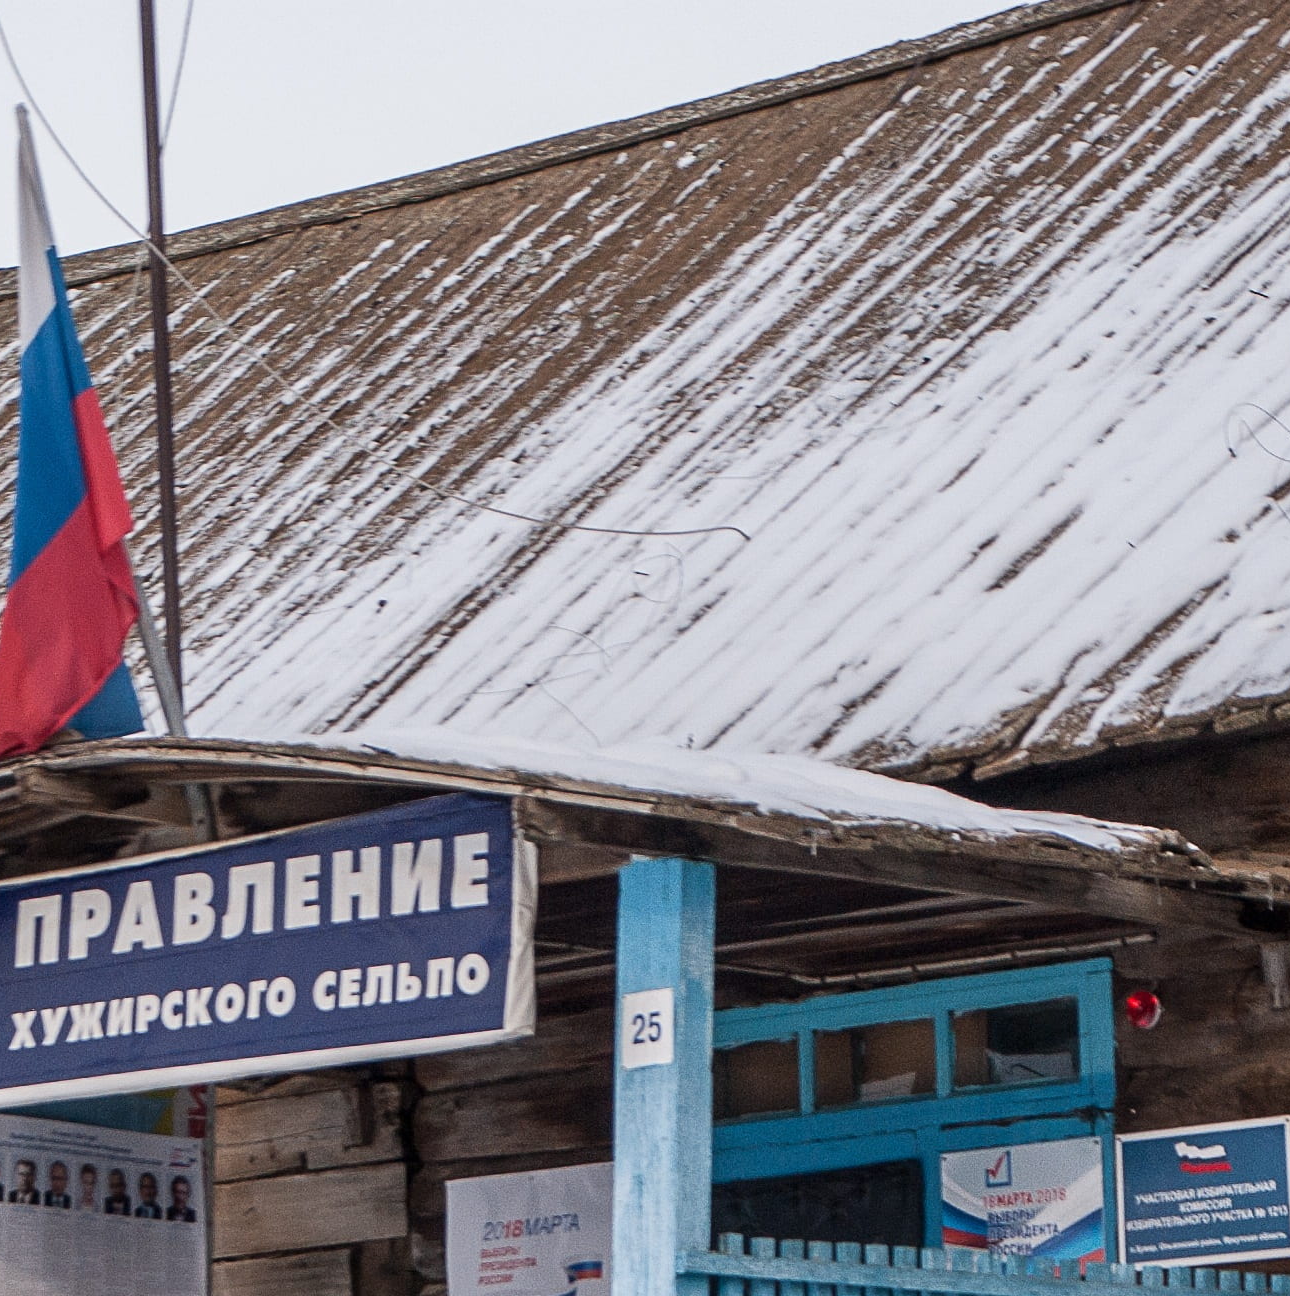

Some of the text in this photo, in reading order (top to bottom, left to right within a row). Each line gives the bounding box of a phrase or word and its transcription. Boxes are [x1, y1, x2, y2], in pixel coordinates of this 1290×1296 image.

[15, 832, 490, 969] ПРАВЛЕНИЕ
[9, 953, 490, 1051] ХУЖИРСКОГО СЕЛЬПО
[632, 1011, 661, 1044] 25
[1134, 1179, 1277, 1205] УЧАСТКОВАЯ ИЗБИРАТЕЛЬНАЯ
[1178, 1197, 1233, 1212] КОМИССИЯ
[988, 1208, 1037, 1225] ВЫБОРЫ
[1126, 1212, 1210, 1231] ИЗБИРАТЕЛЬНОГО
[1211, 1207, 1253, 1223] УЧАСТКА
[988, 1223, 1060, 1240] ПРЕЗИДЕНТА
